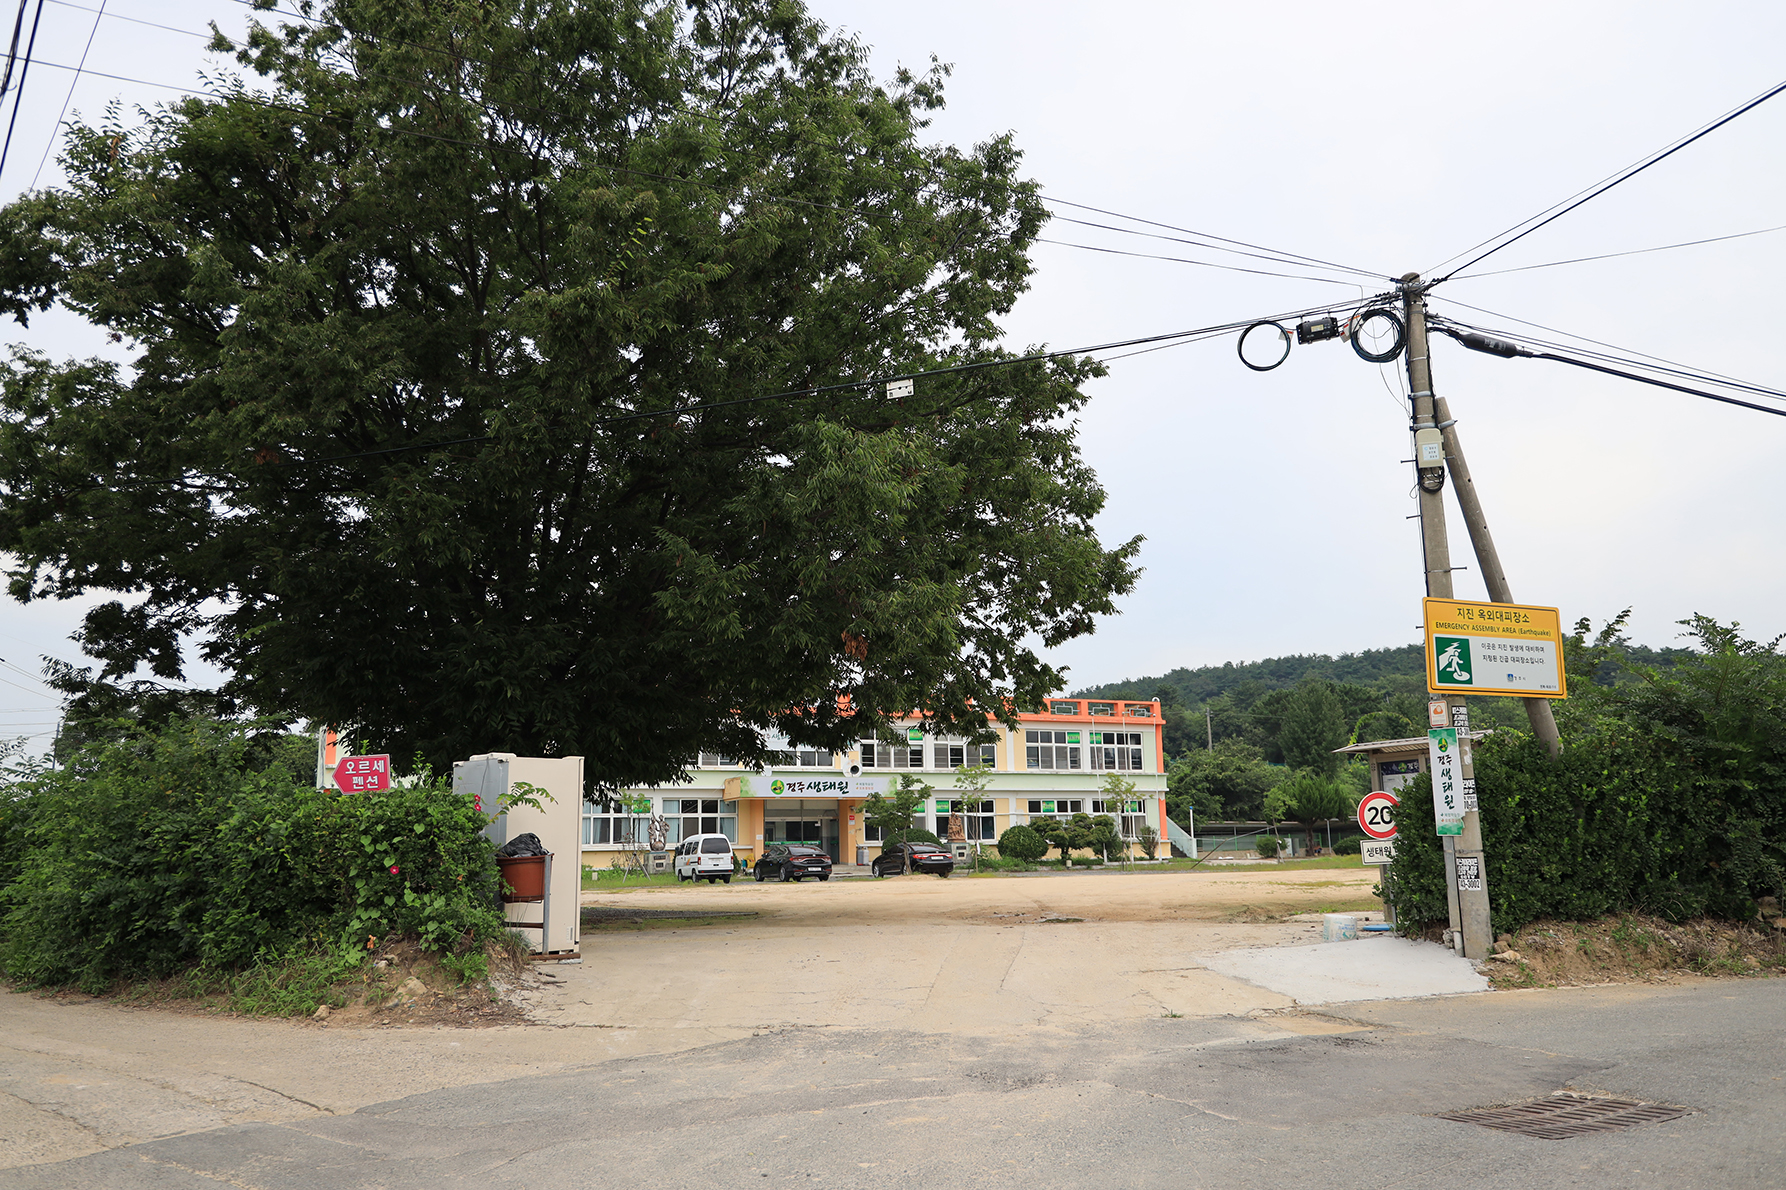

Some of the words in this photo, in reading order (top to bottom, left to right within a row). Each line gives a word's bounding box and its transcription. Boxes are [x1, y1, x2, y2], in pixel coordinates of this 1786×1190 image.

[1456, 608, 1475, 620] 지진
[1478, 608, 1530, 623] 옥외대피장소
[1436, 622, 1470, 631] EMERGENCY
[1472, 624, 1500, 633] ASSEMBLY
[1518, 628, 1552, 638] (Earthquake)
[1481, 642, 1496, 650] 이곳은
[1499, 655, 1509, 663] 긴급
[345, 759, 385, 775] 오르세
[1437, 754, 1453, 766] 경주
[352, 775, 379, 790] 펜션
[786, 782, 806, 793] 경주
[806, 781, 850, 794] 생태원
[1441, 767, 1455, 810] 생태원
[1367, 806, 1393, 825] 20
[1366, 846, 1392, 859] 생태원
